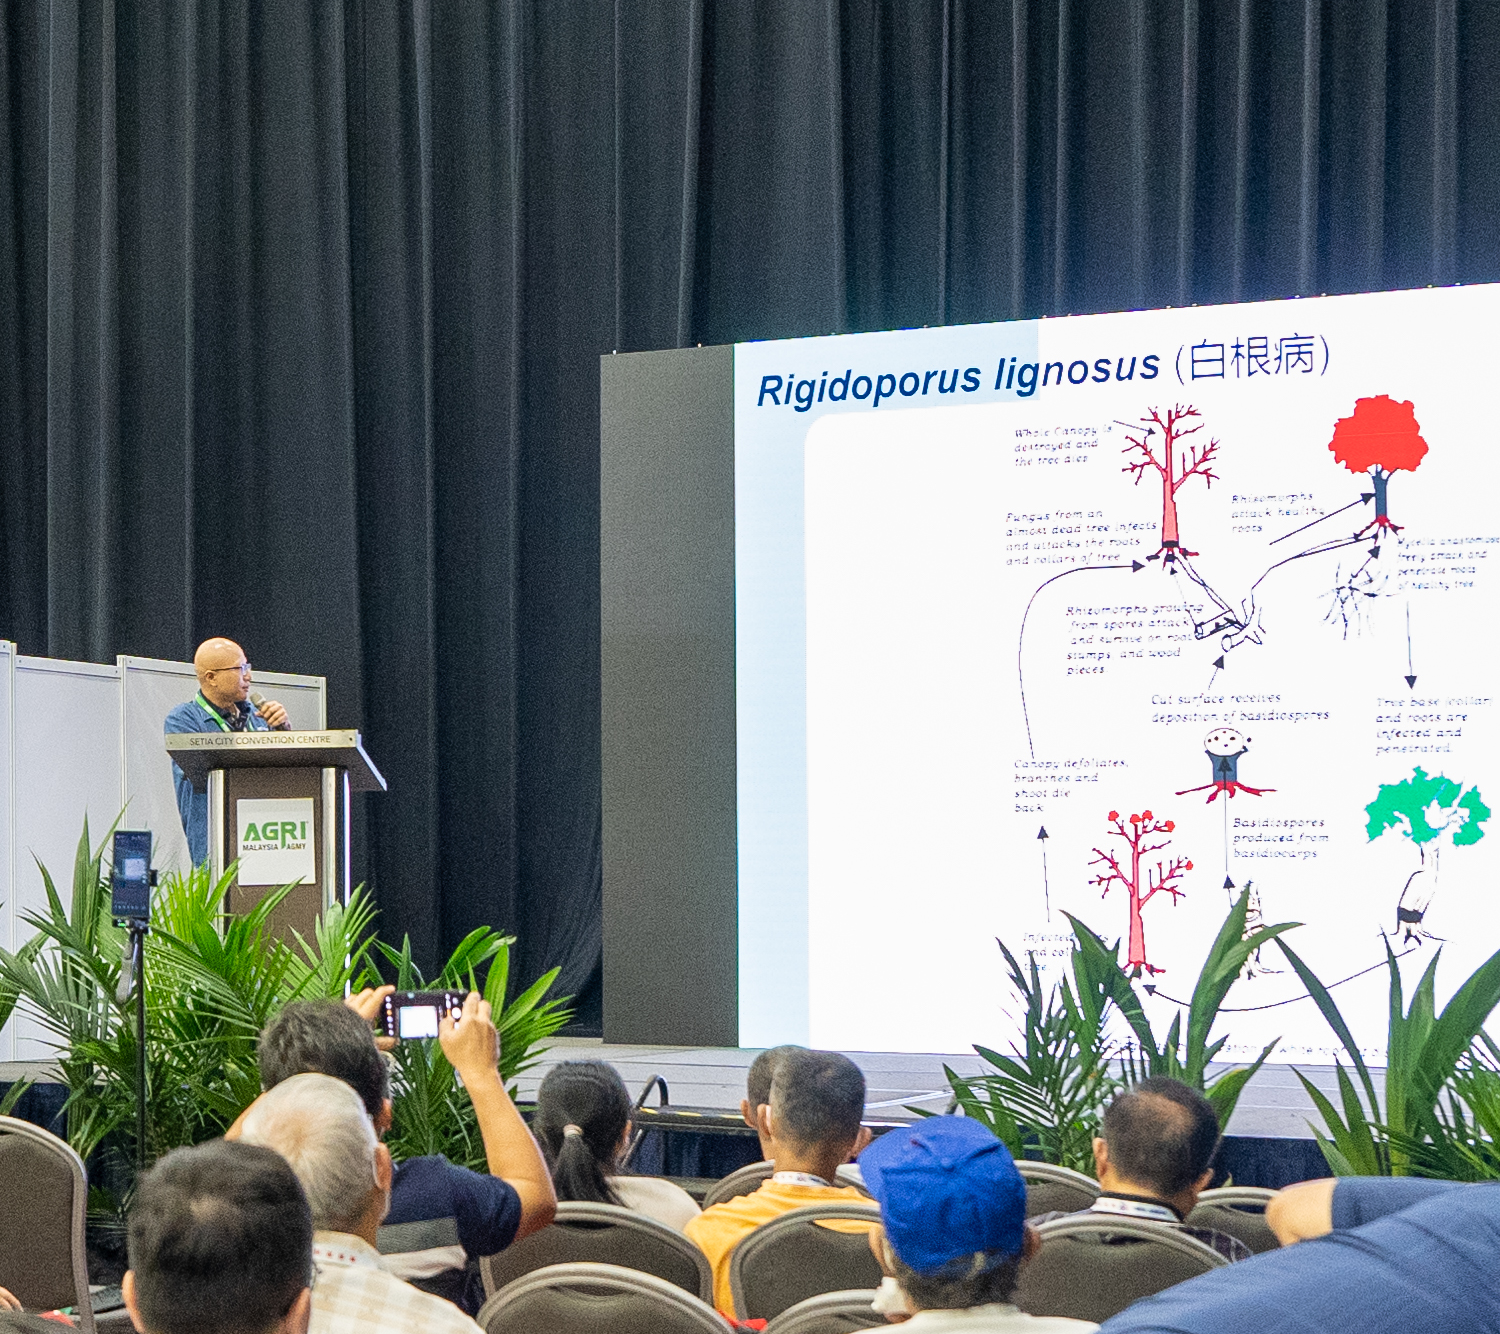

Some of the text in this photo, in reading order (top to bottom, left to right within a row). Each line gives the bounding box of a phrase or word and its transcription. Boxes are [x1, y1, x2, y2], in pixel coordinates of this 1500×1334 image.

[757, 334, 1331, 412] Rigidoporus lignosus (白根病)
[190, 735, 331, 746] SETIA CITY CONVENTION CENTRE
[243, 821, 306, 849] AGRI
